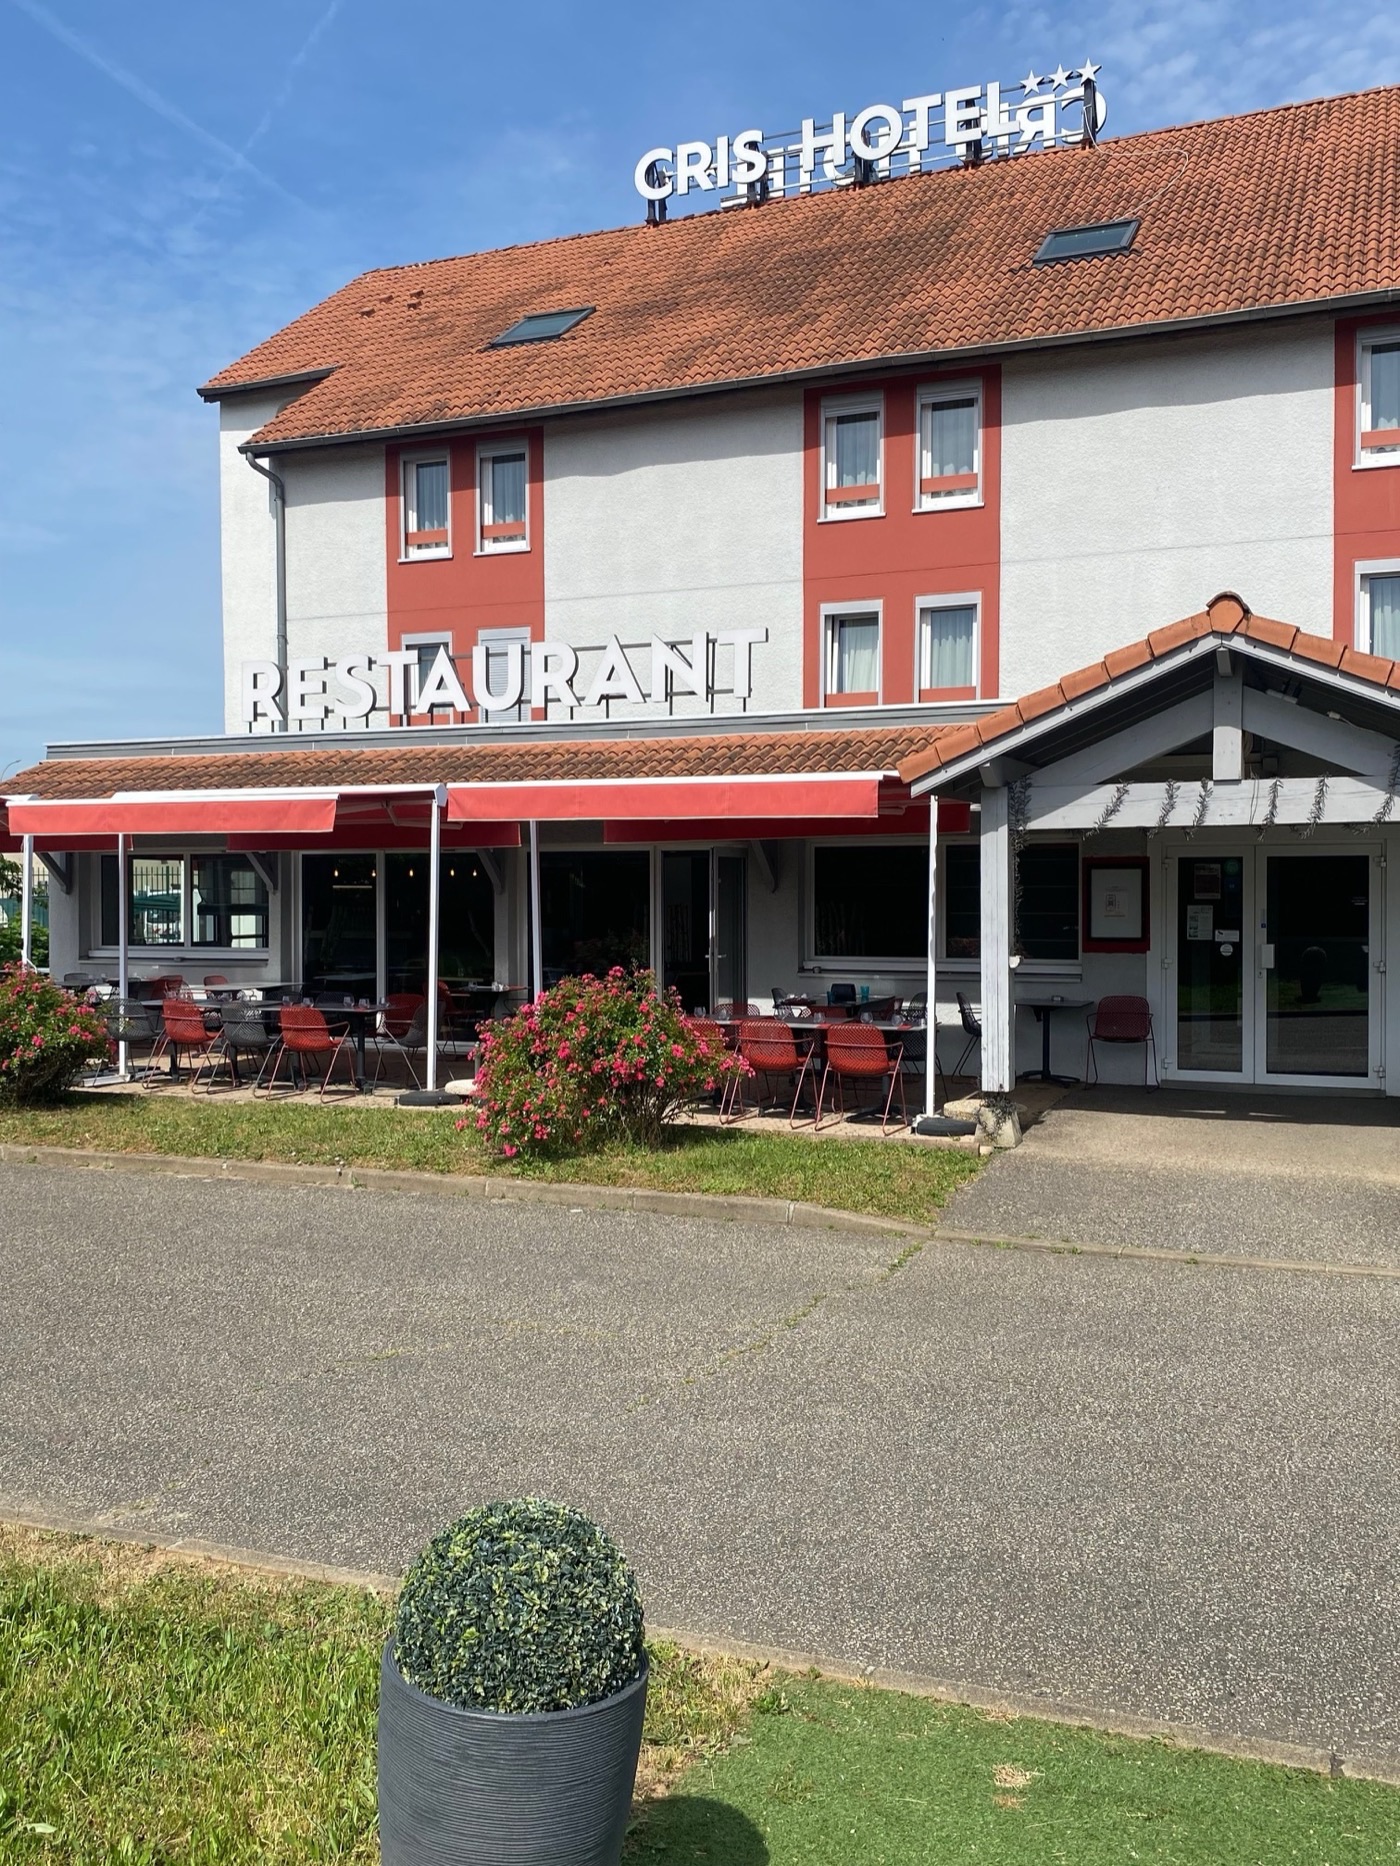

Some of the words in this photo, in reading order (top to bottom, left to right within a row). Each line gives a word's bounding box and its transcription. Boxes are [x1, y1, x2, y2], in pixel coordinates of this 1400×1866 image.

[634, 129, 768, 201] CRIS
[802, 81, 1021, 173] HOTEL
[241, 627, 769, 723] RESTAURANT
